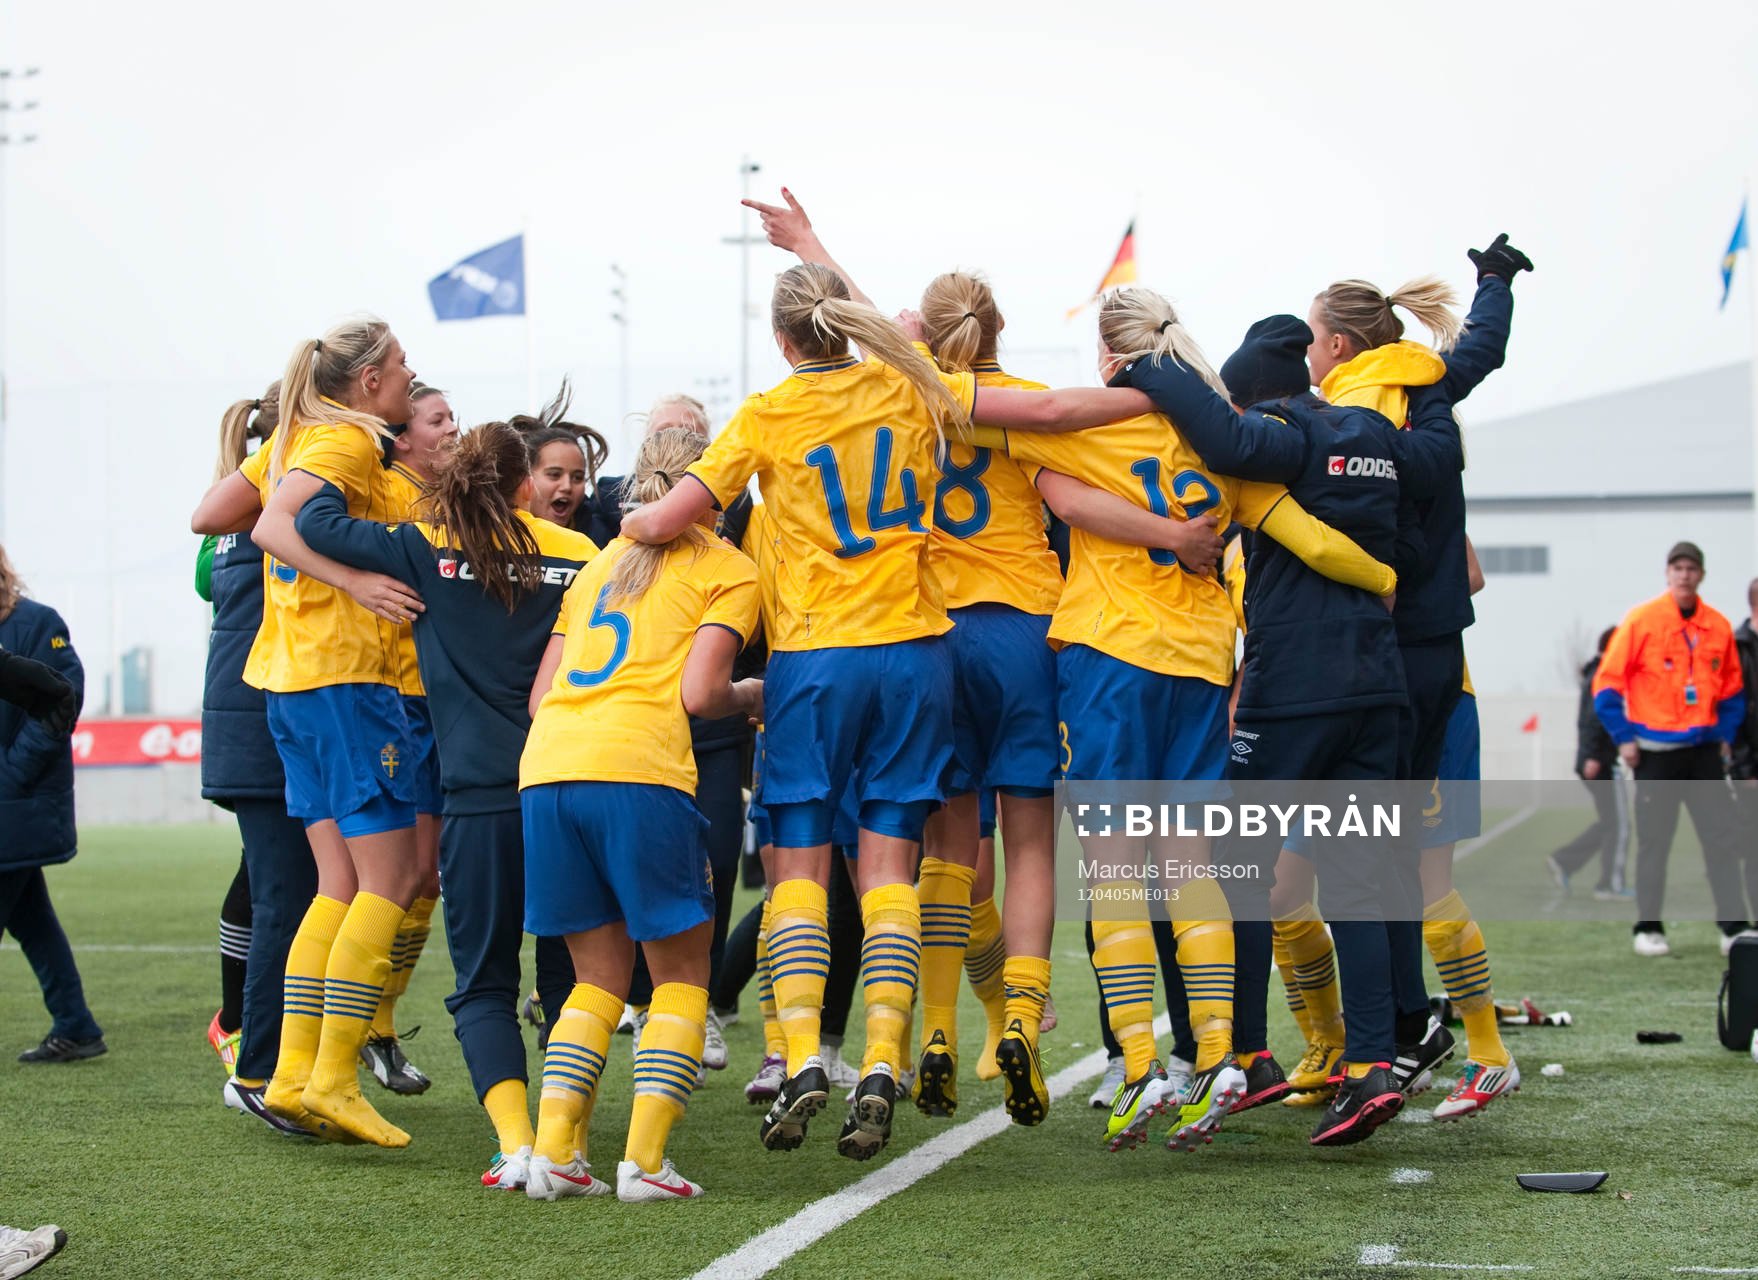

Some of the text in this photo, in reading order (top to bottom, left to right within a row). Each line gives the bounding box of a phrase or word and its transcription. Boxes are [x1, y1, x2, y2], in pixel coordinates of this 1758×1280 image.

[805, 426, 930, 559] 14
[933, 438, 991, 540] 8
[567, 580, 637, 688] 5
